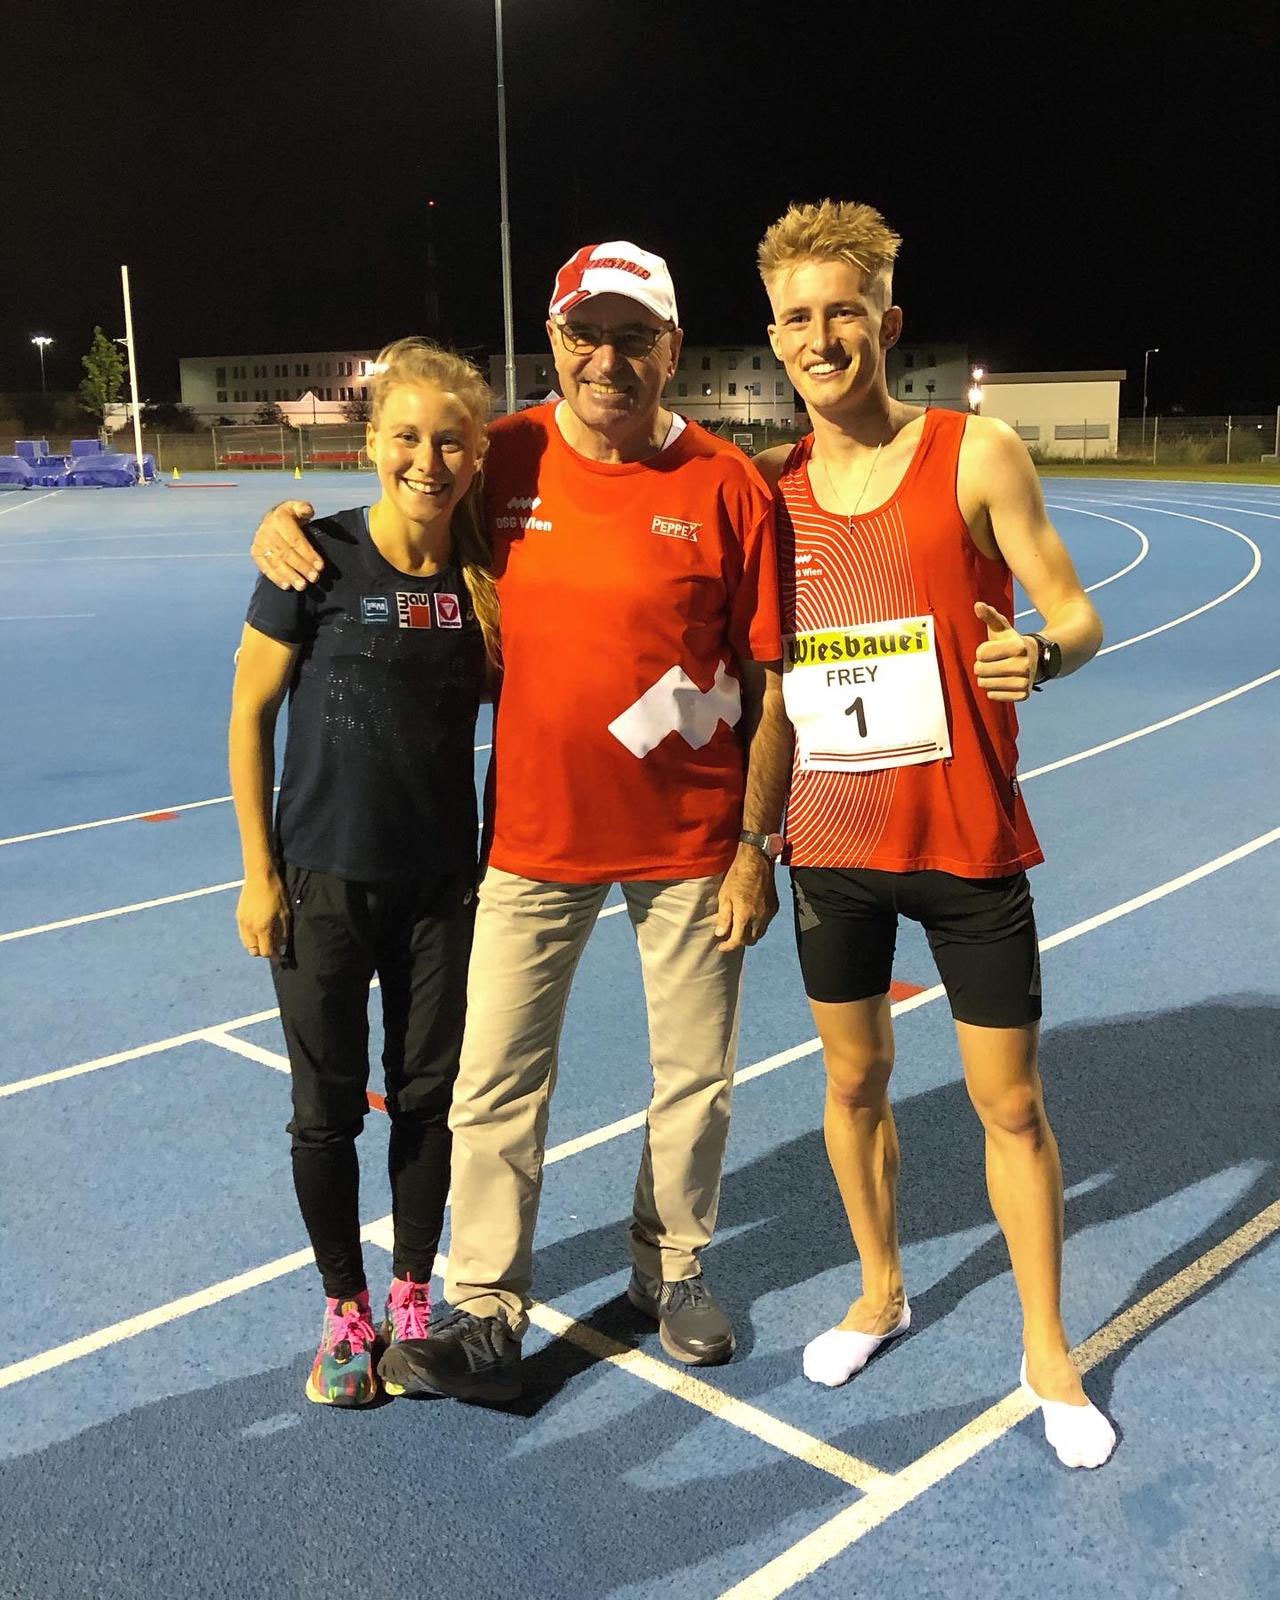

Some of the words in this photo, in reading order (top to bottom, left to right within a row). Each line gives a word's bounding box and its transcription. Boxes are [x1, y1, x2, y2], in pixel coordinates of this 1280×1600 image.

[519, 516, 553, 532] Wien
[826, 665, 878, 687] FREY
[845, 696, 868, 738] 1
